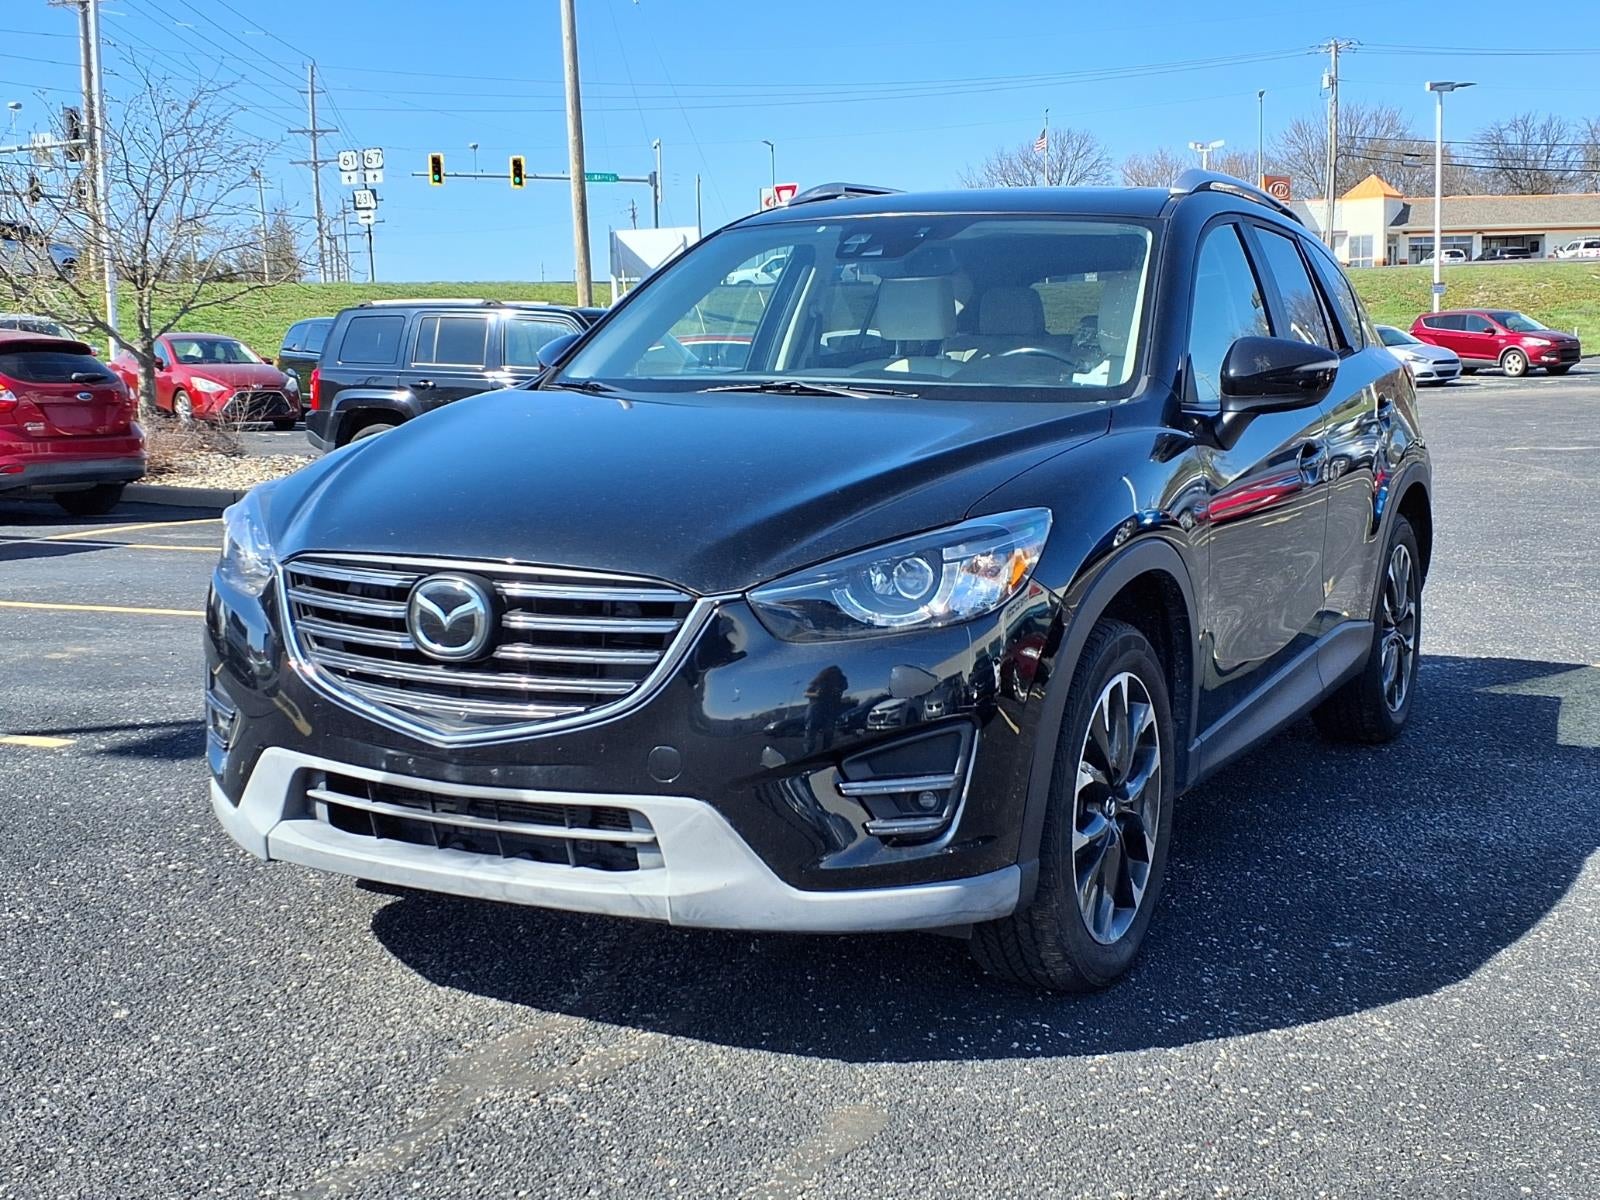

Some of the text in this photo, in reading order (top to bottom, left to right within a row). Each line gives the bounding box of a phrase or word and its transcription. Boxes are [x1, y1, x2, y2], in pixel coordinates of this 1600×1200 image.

[342, 154, 355, 166] 61
[366, 153, 381, 164] 67
[357, 193, 372, 205] 231
